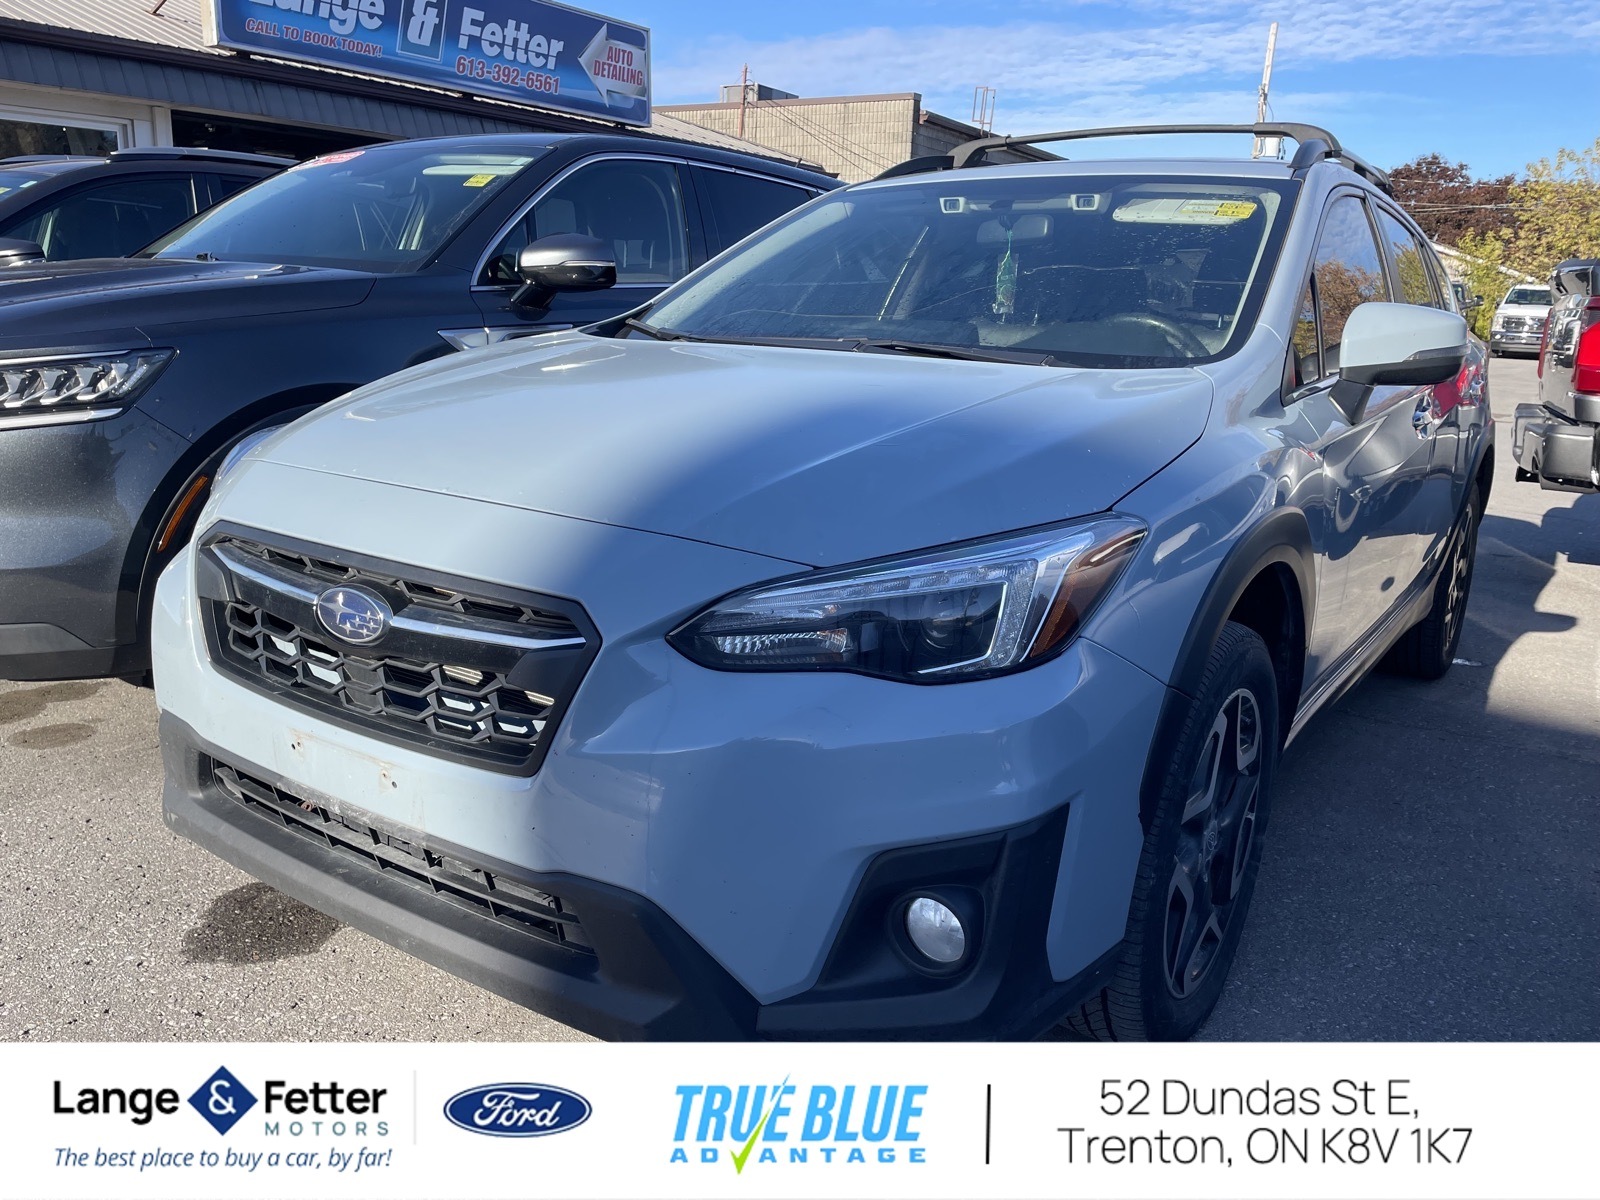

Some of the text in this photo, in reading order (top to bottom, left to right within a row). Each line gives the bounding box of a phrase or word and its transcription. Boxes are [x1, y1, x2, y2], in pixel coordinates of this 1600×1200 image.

[245, 17, 383, 58] CALL TO BOOK TODAY!
[248, 0, 565, 70] nge & Fetter
[455, 55, 561, 95] 613-392-6561
[592, 59, 644, 87] DETAILING
[606, 45, 634, 67] AUTO
